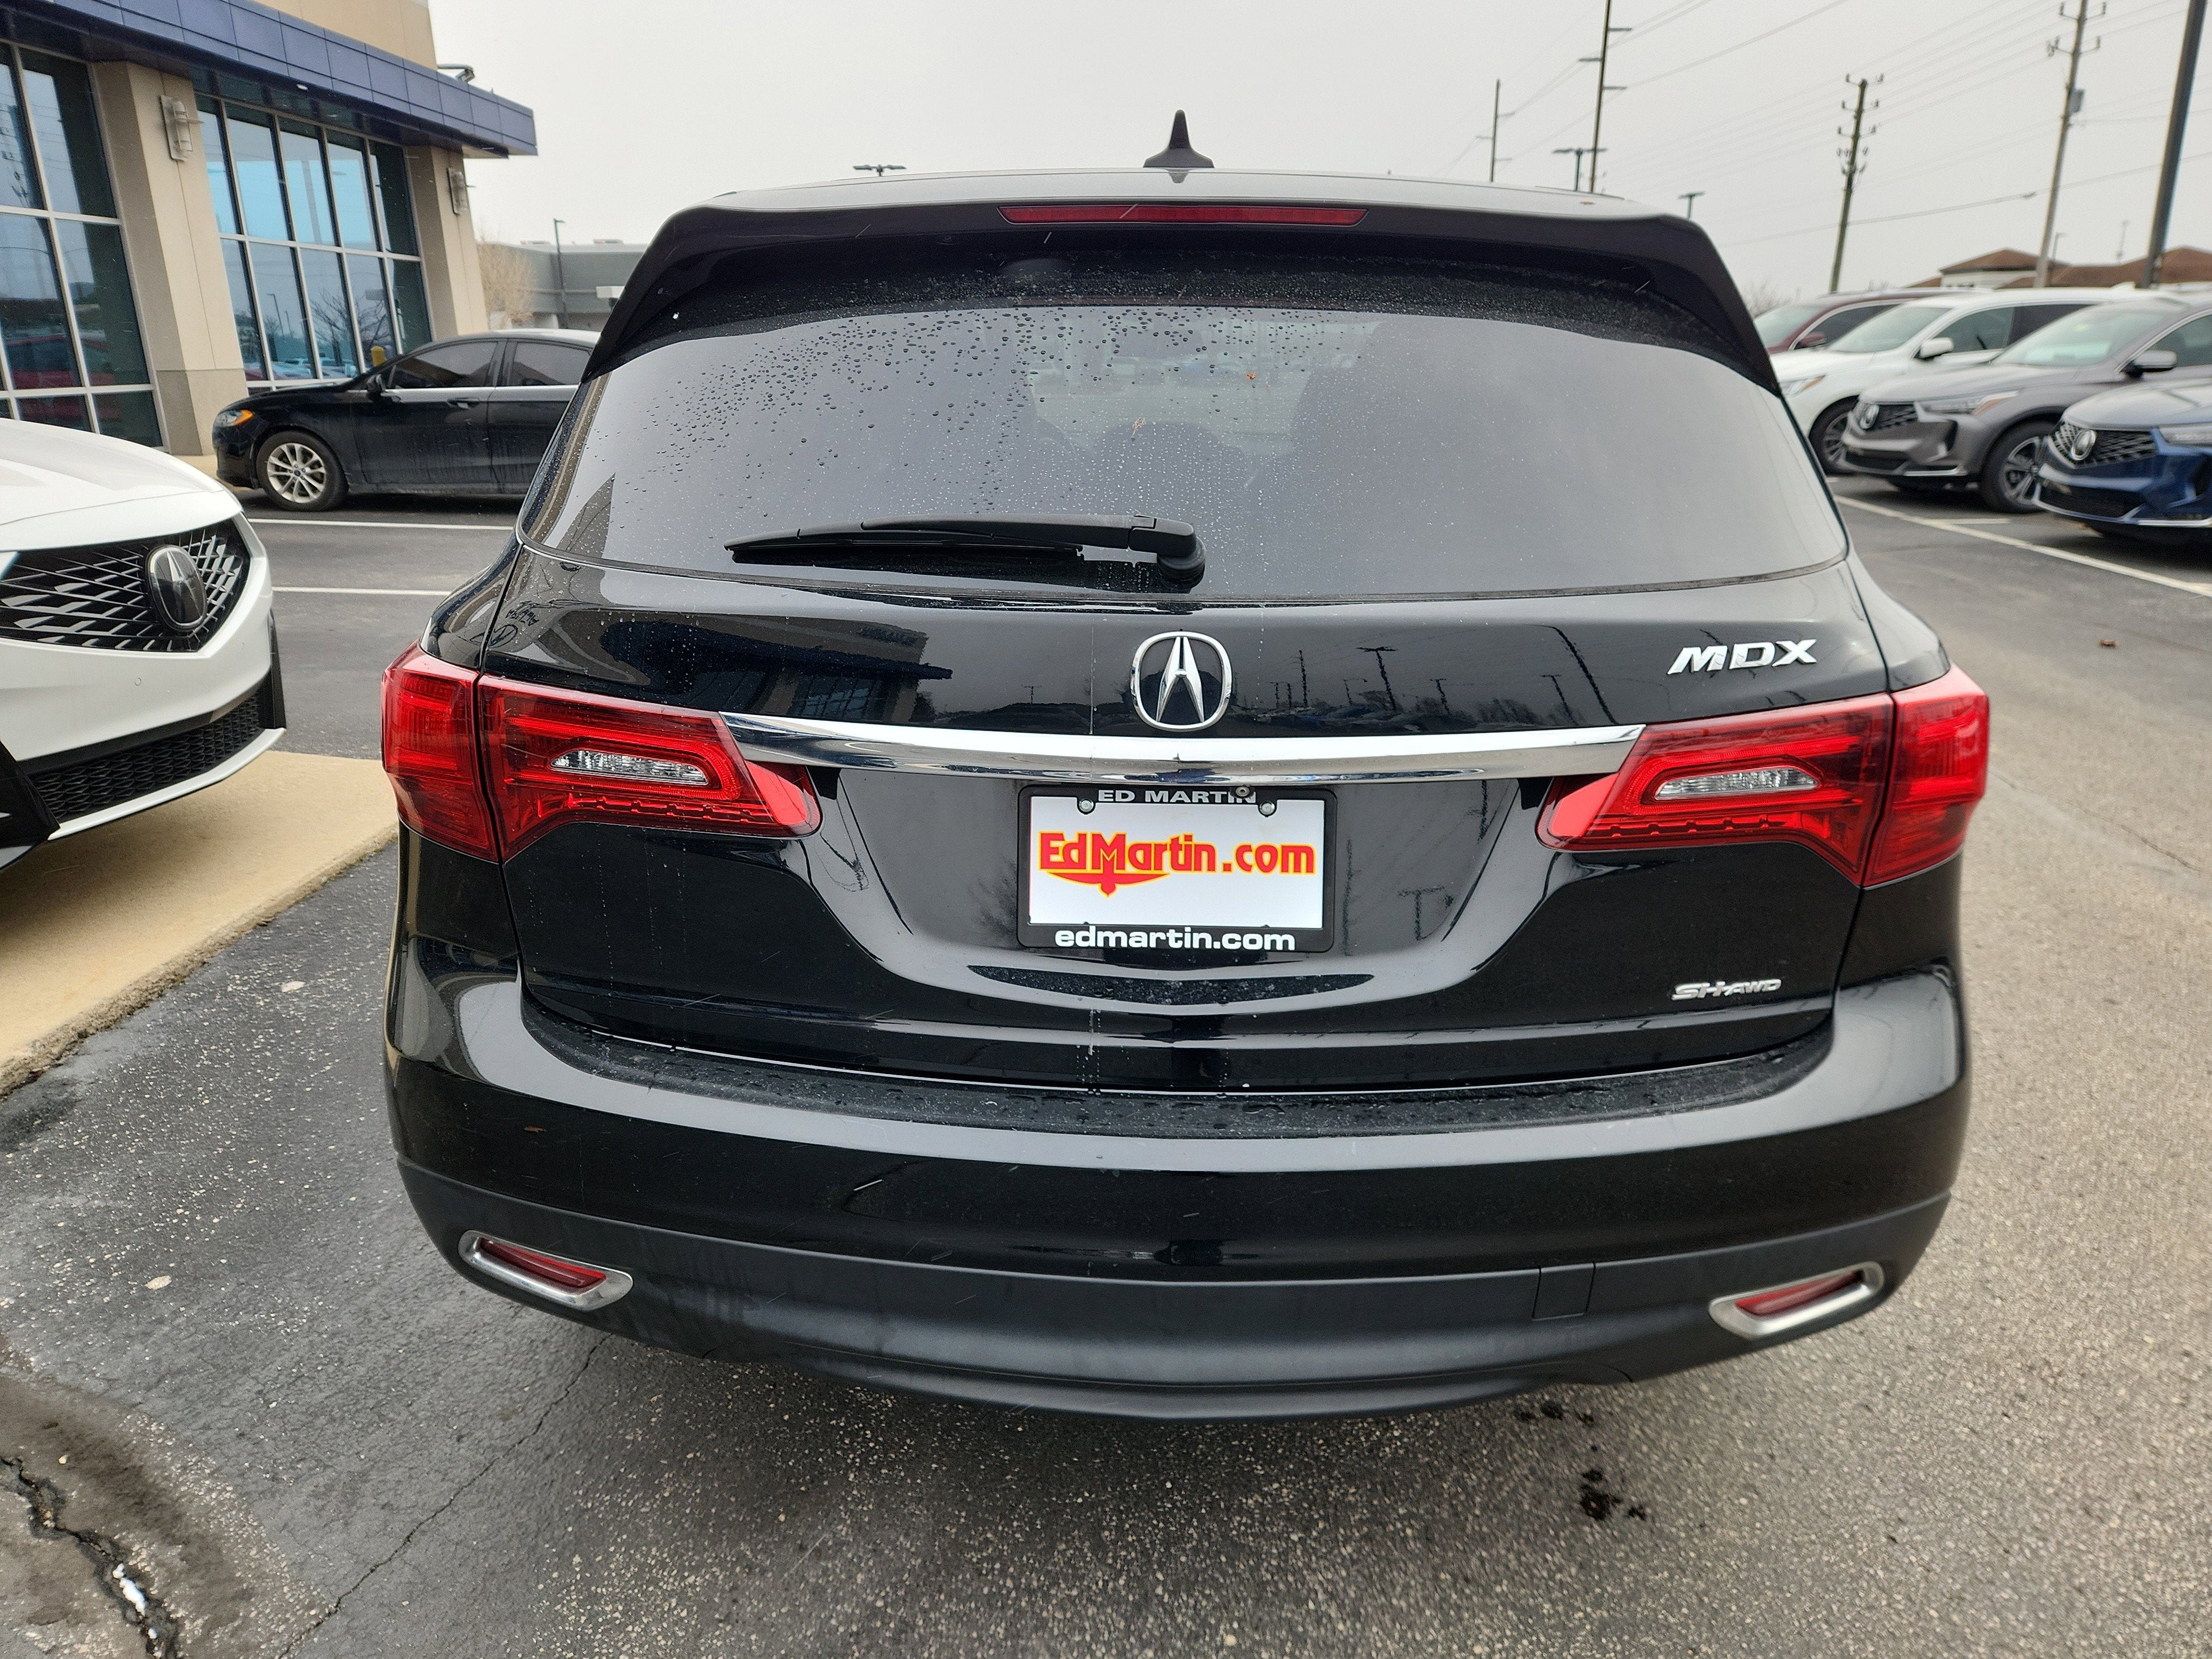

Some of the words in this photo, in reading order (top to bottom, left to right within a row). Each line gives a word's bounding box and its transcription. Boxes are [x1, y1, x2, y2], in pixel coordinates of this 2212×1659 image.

[1667, 639, 1817, 675] MDX
[1098, 790, 1135, 802] ED
[1039, 832, 1317, 876] EdMartin.com
[1054, 925, 1296, 951] edmartin.com
